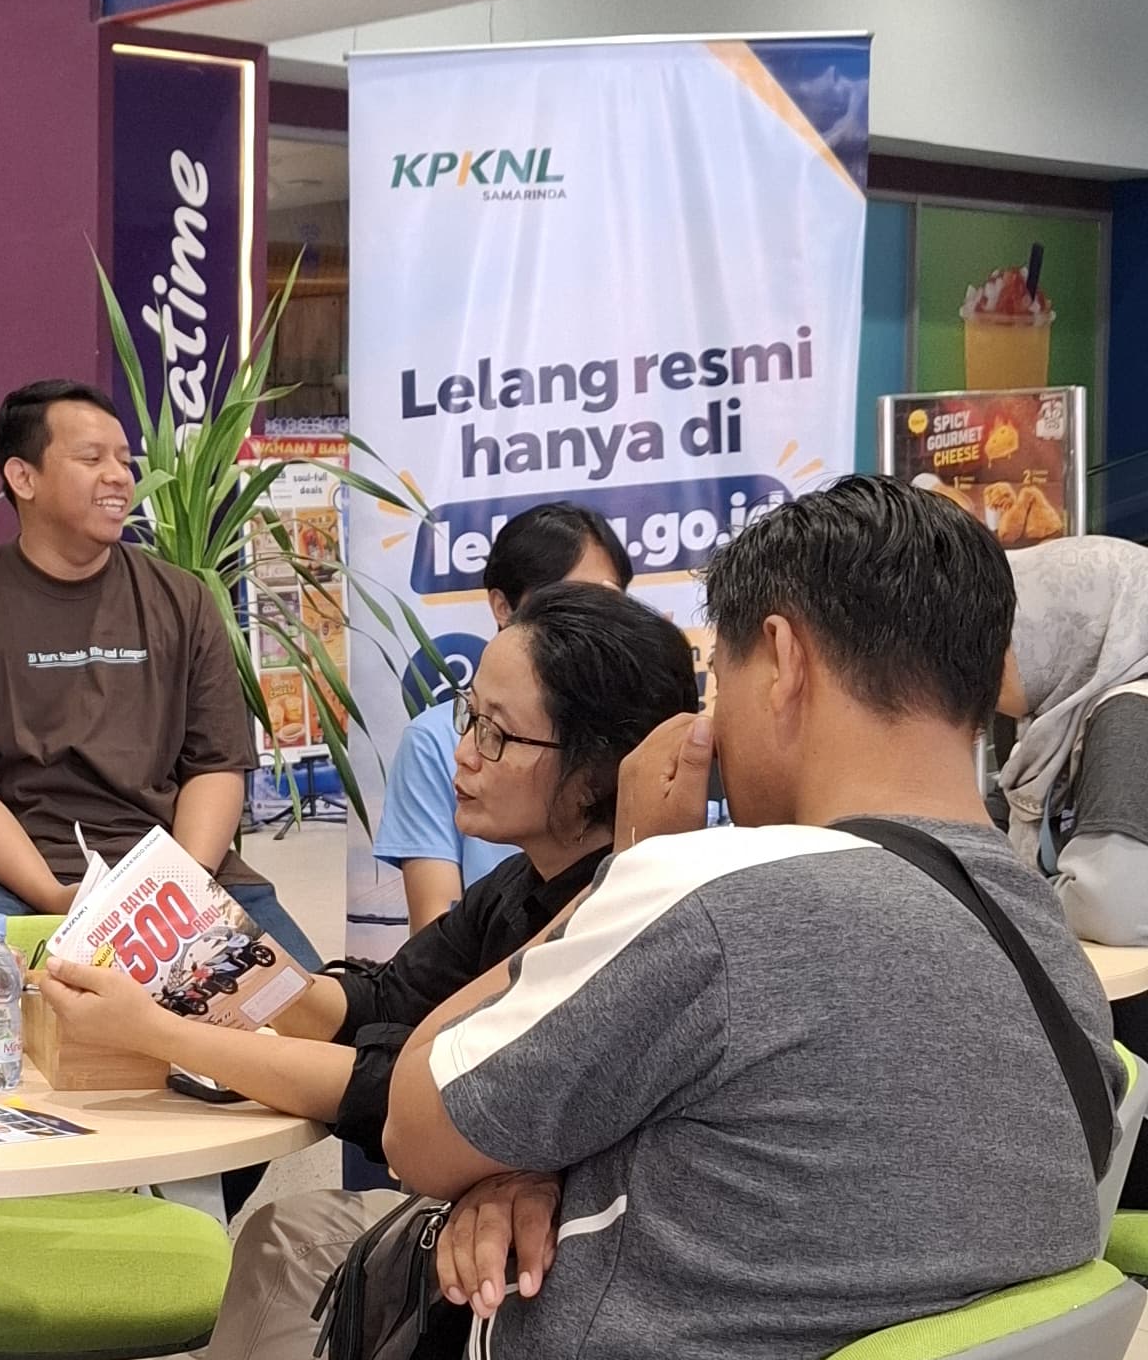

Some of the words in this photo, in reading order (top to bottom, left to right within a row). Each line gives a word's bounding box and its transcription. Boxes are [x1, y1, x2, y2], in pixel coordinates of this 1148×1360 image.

[391, 146, 565, 189] KPKNL
[482, 188, 567, 201] SAMARINDA
[400, 351, 620, 420] Lelang
[633, 326, 813, 392] resmi
[461, 418, 665, 480] hanya
[680, 398, 743, 458] di
[927, 425, 984, 451] GOURMET
[933, 410, 971, 433] SPICY
[933, 445, 980, 467] CHEESE
[434, 490, 785, 576] le.go.i
[86, 910, 122, 948] CUKUP
[120, 877, 159, 915] BAYAR
[110, 881, 200, 985] 500
[194, 904, 221, 934] RIBU
